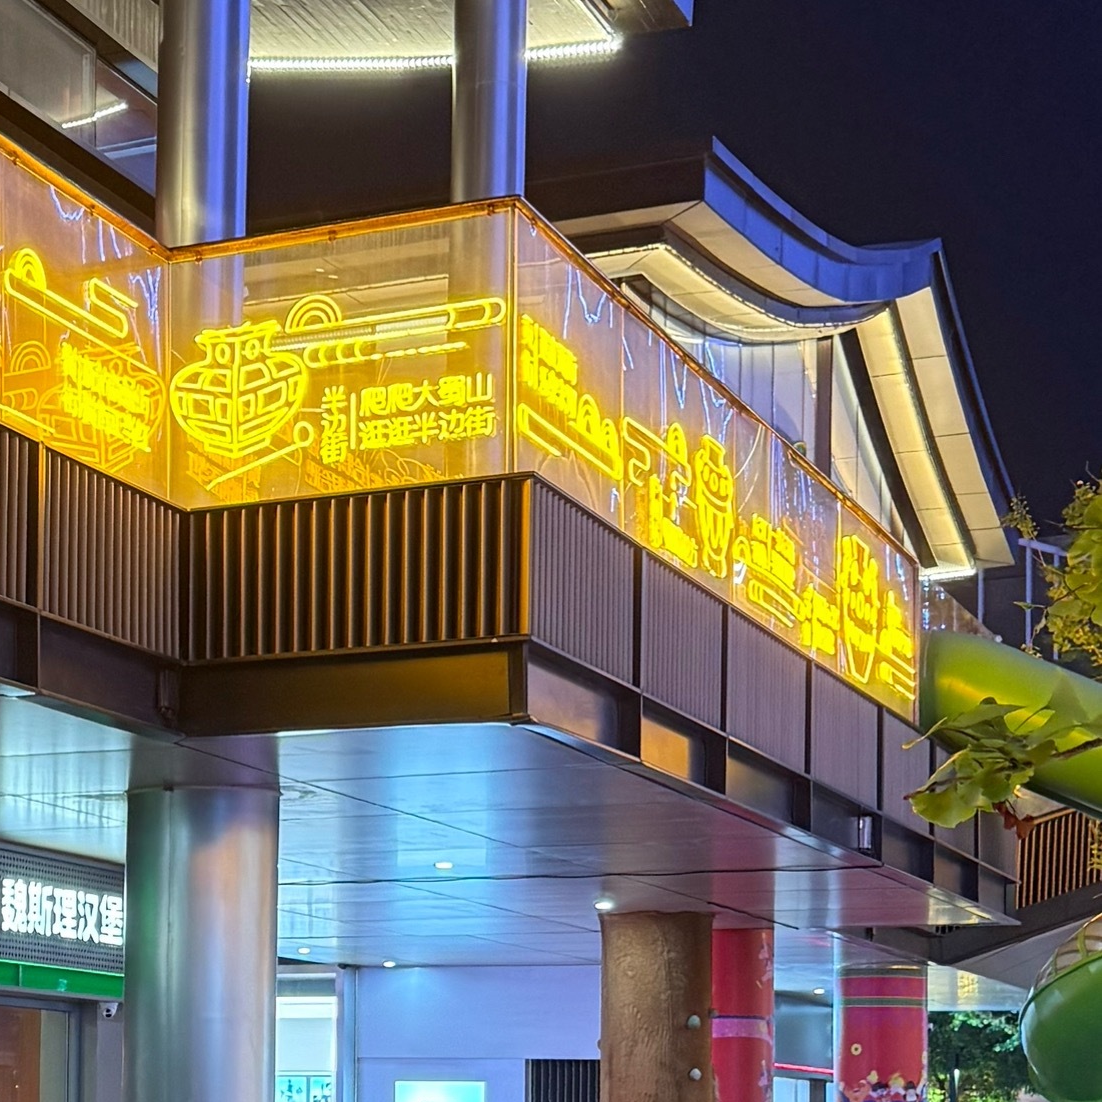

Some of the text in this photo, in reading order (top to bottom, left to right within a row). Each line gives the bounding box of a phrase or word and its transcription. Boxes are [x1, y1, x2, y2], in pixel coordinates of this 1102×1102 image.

[359, 372, 494, 417] 爬爬大蜀山
[320, 385, 348, 464] 半边街
[358, 406, 496, 450] 逛逛半边街
[1, 878, 124, 946] 魏斯理汉堡
